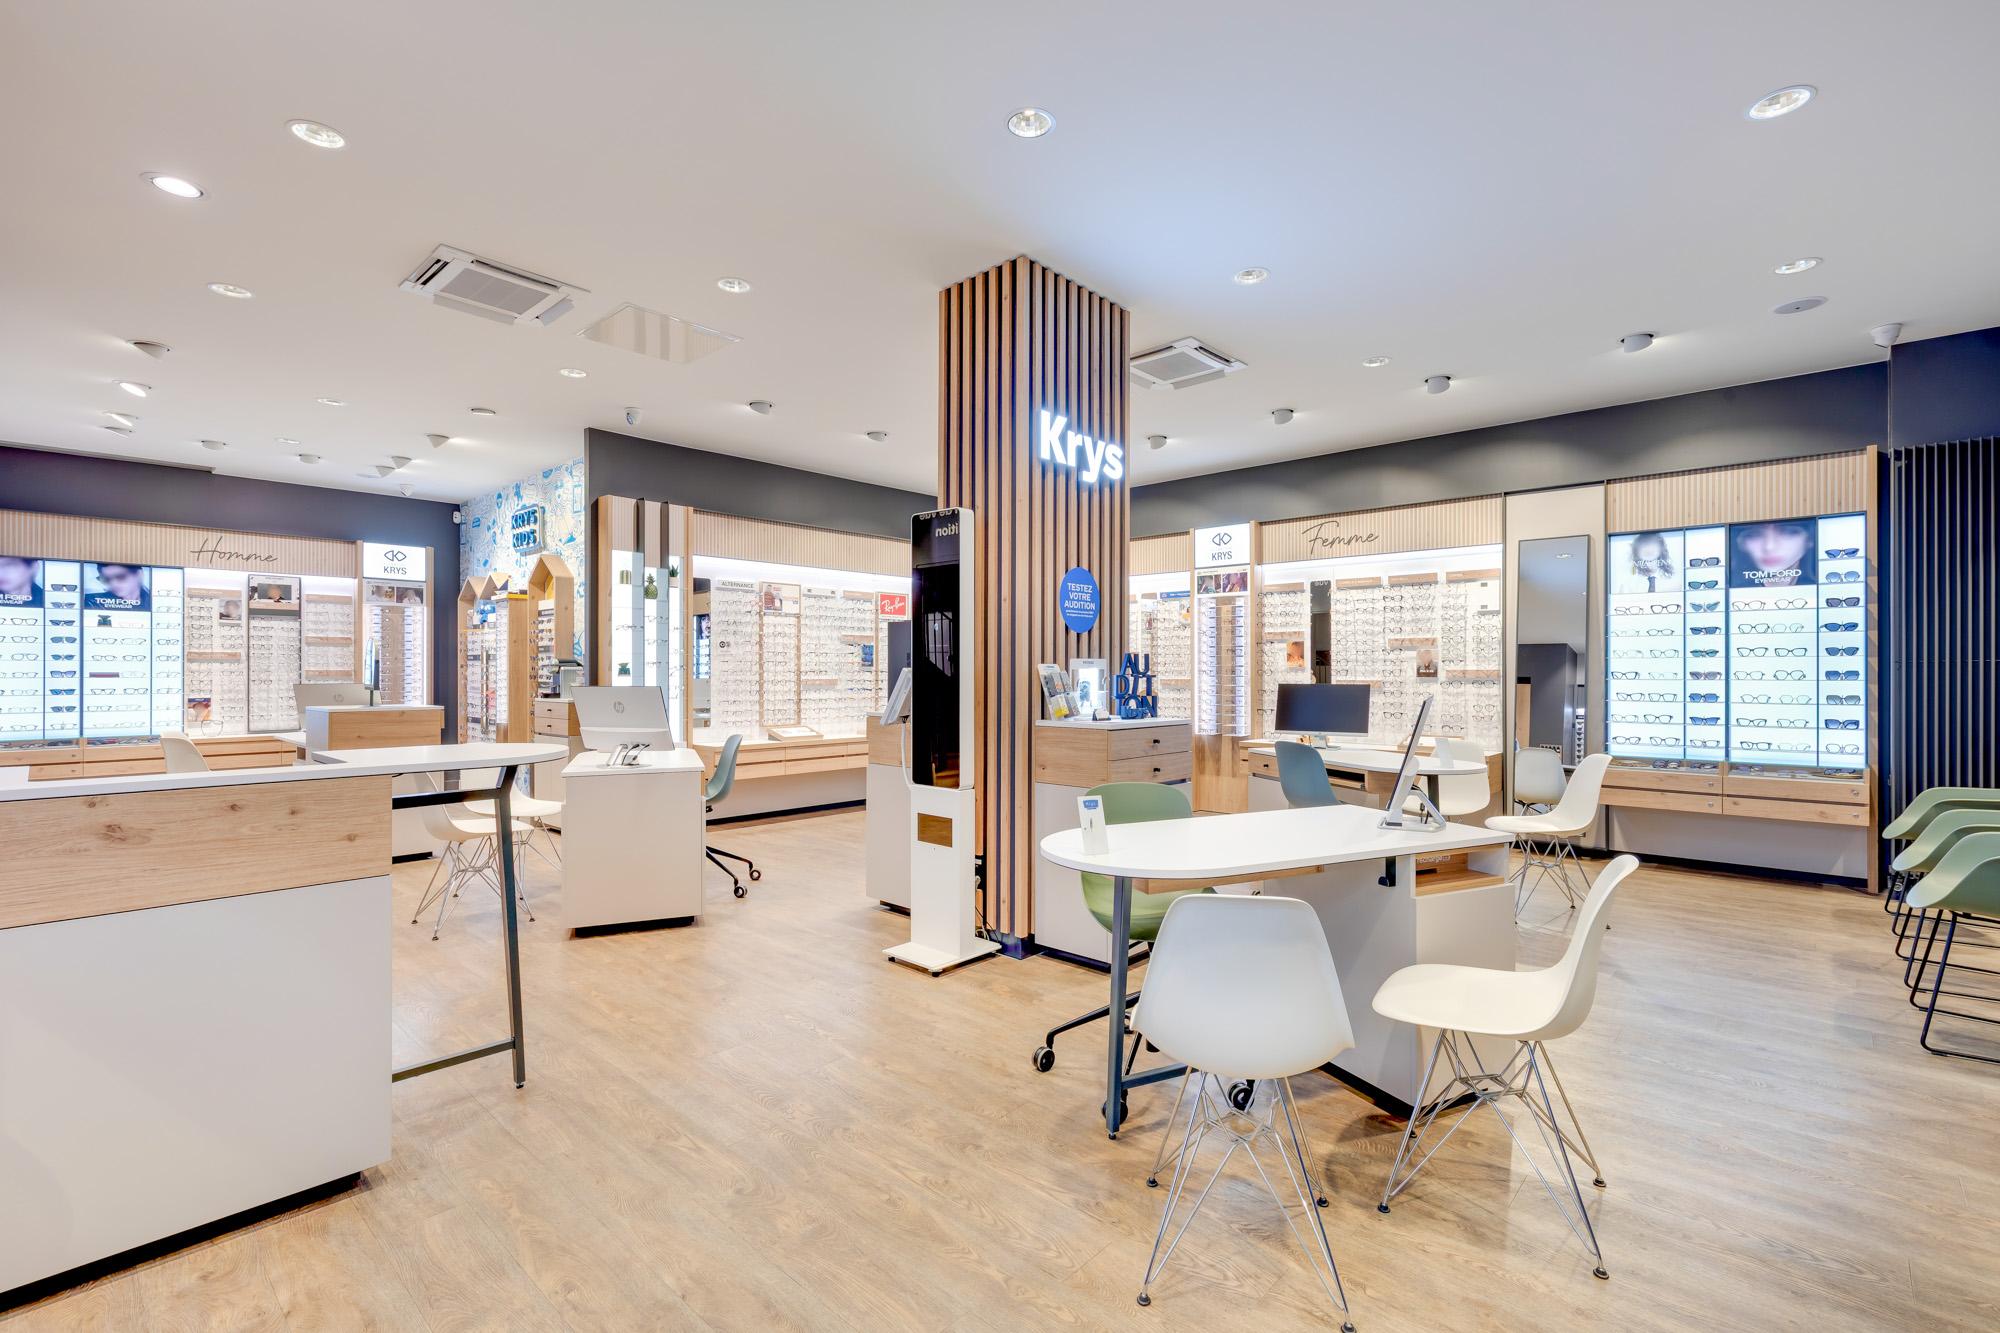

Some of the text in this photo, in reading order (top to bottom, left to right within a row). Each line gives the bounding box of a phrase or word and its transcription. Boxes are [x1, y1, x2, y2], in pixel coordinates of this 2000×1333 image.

[1040, 408, 1123, 483] Krys
[511, 509, 538, 530] KRYS
[511, 529, 538, 548] KIDS
[1302, 521, 1379, 554] Femme
[190, 536, 279, 564] Homme
[1211, 551, 1233, 561] KRYS
[383, 565, 407, 575] KRYS
[1742, 569, 1802, 579] TOM FORD
[1067, 582, 1093, 593] TESTEZ
[5, 594, 32, 602] FORD
[1069, 592, 1091, 601] VOTRE
[1064, 600, 1096, 610] AUDITION
